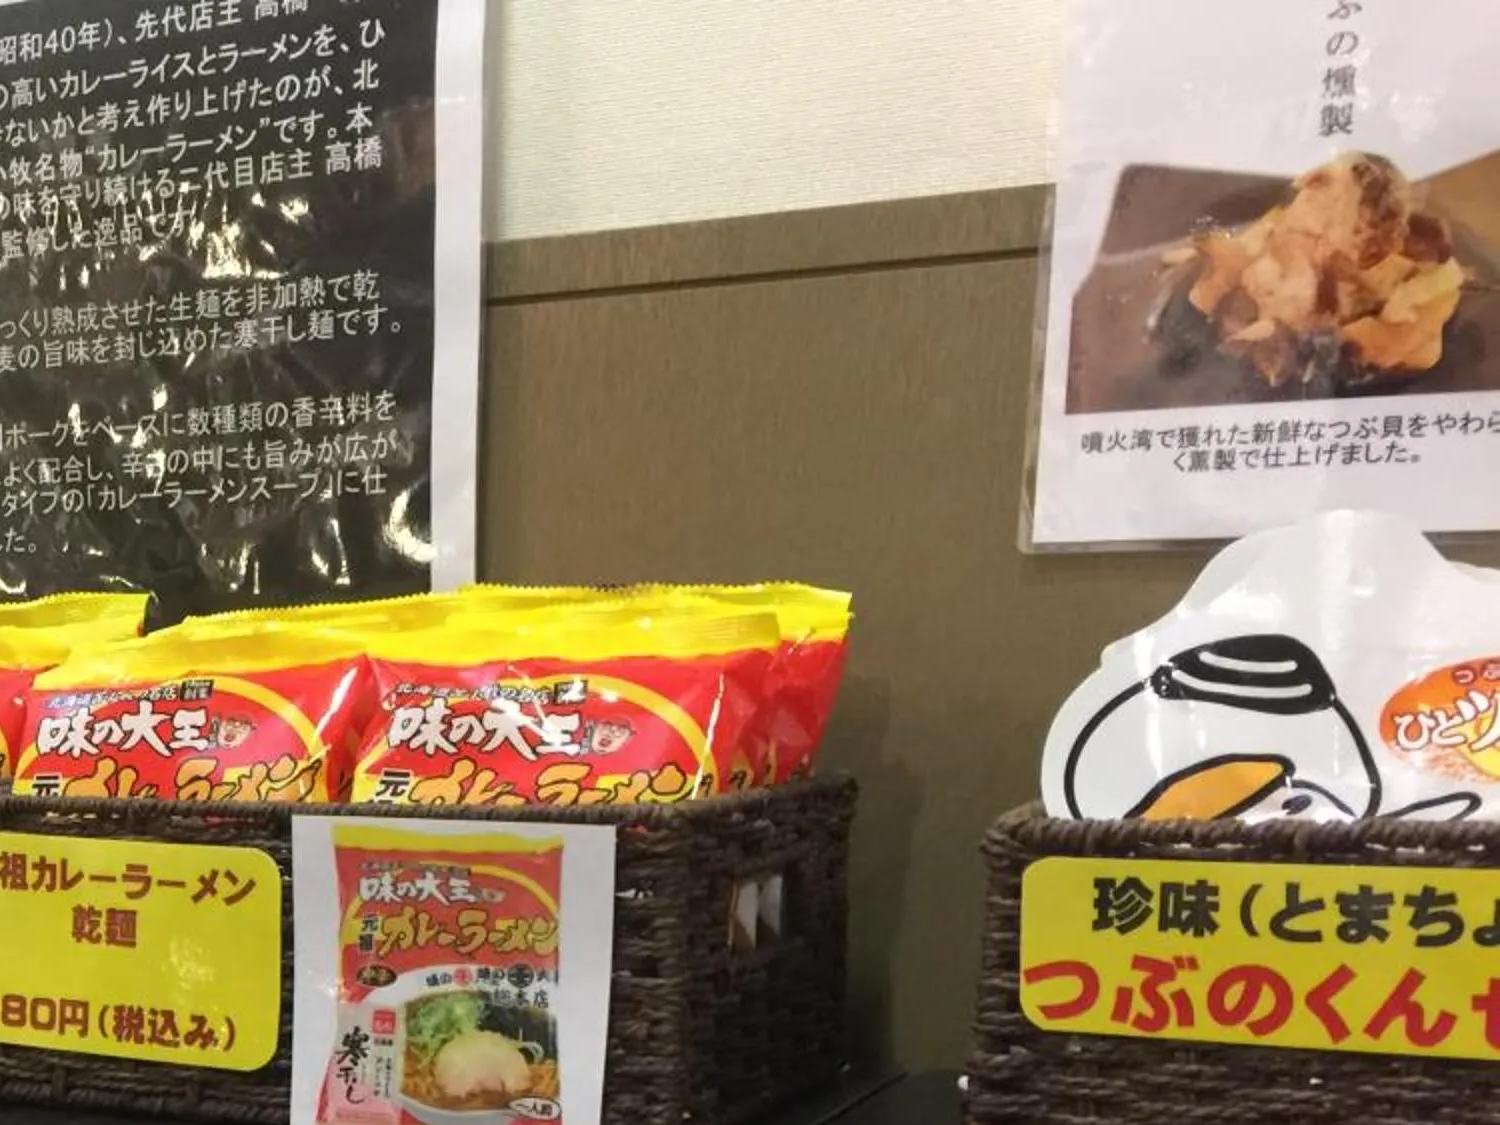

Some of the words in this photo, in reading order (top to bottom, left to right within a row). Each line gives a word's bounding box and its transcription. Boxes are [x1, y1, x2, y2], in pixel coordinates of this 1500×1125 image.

[324, 135, 384, 175] 高橋
[35, 698, 210, 759] 味の大王
[388, 697, 583, 761] 味の大王
[359, 871, 477, 906] 味の大王
[71, 905, 138, 949] 乾麺
